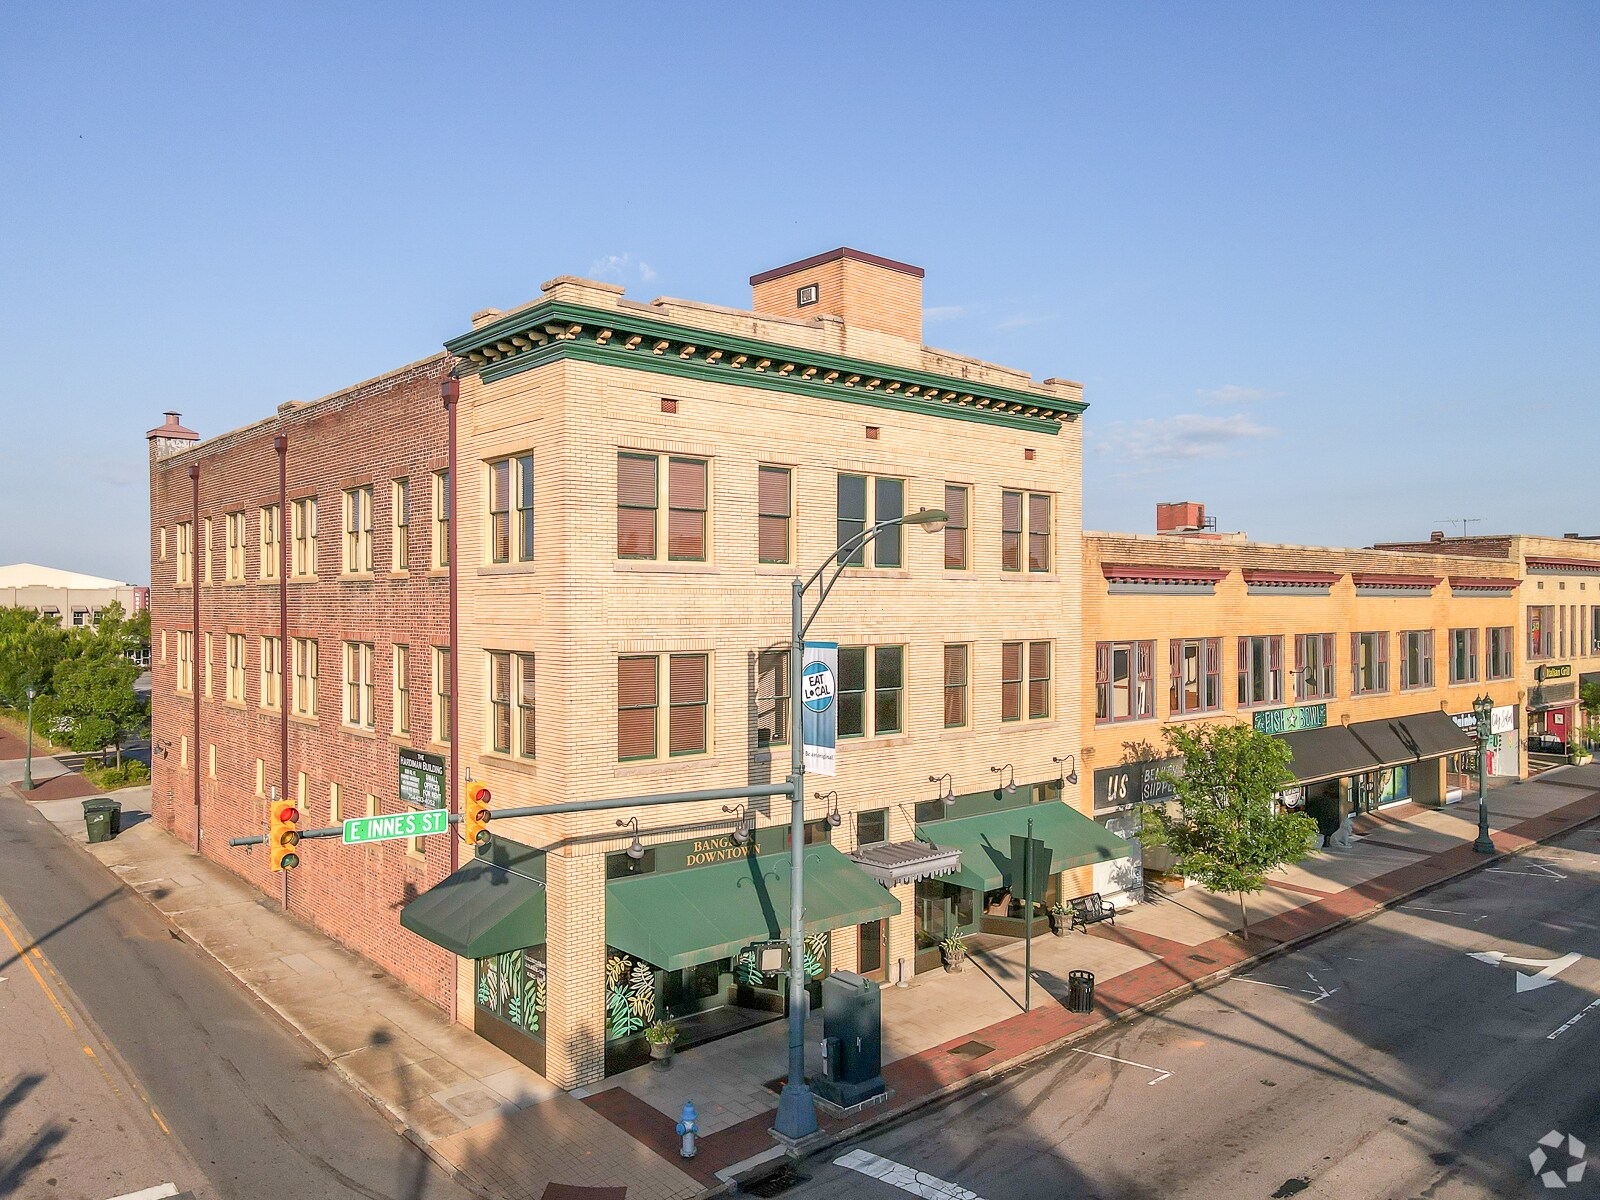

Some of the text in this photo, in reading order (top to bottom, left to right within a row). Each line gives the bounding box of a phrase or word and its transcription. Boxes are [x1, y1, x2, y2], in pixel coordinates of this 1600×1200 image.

[1561, 666, 1570, 676] Grill
[808, 673, 824, 687] EAT
[1265, 709, 1286, 733] FISH
[1299, 705, 1322, 728] BOWL
[1452, 713, 1477, 728] Rainbo
[422, 762, 443, 775] BUILDING
[425, 774, 438, 783] SMALL
[1107, 774, 1129, 802] US
[1143, 781, 1177, 799] SUPPL
[351, 813, 442, 840] E INNES ST
[686, 843, 761, 867] DOWNTOWN
